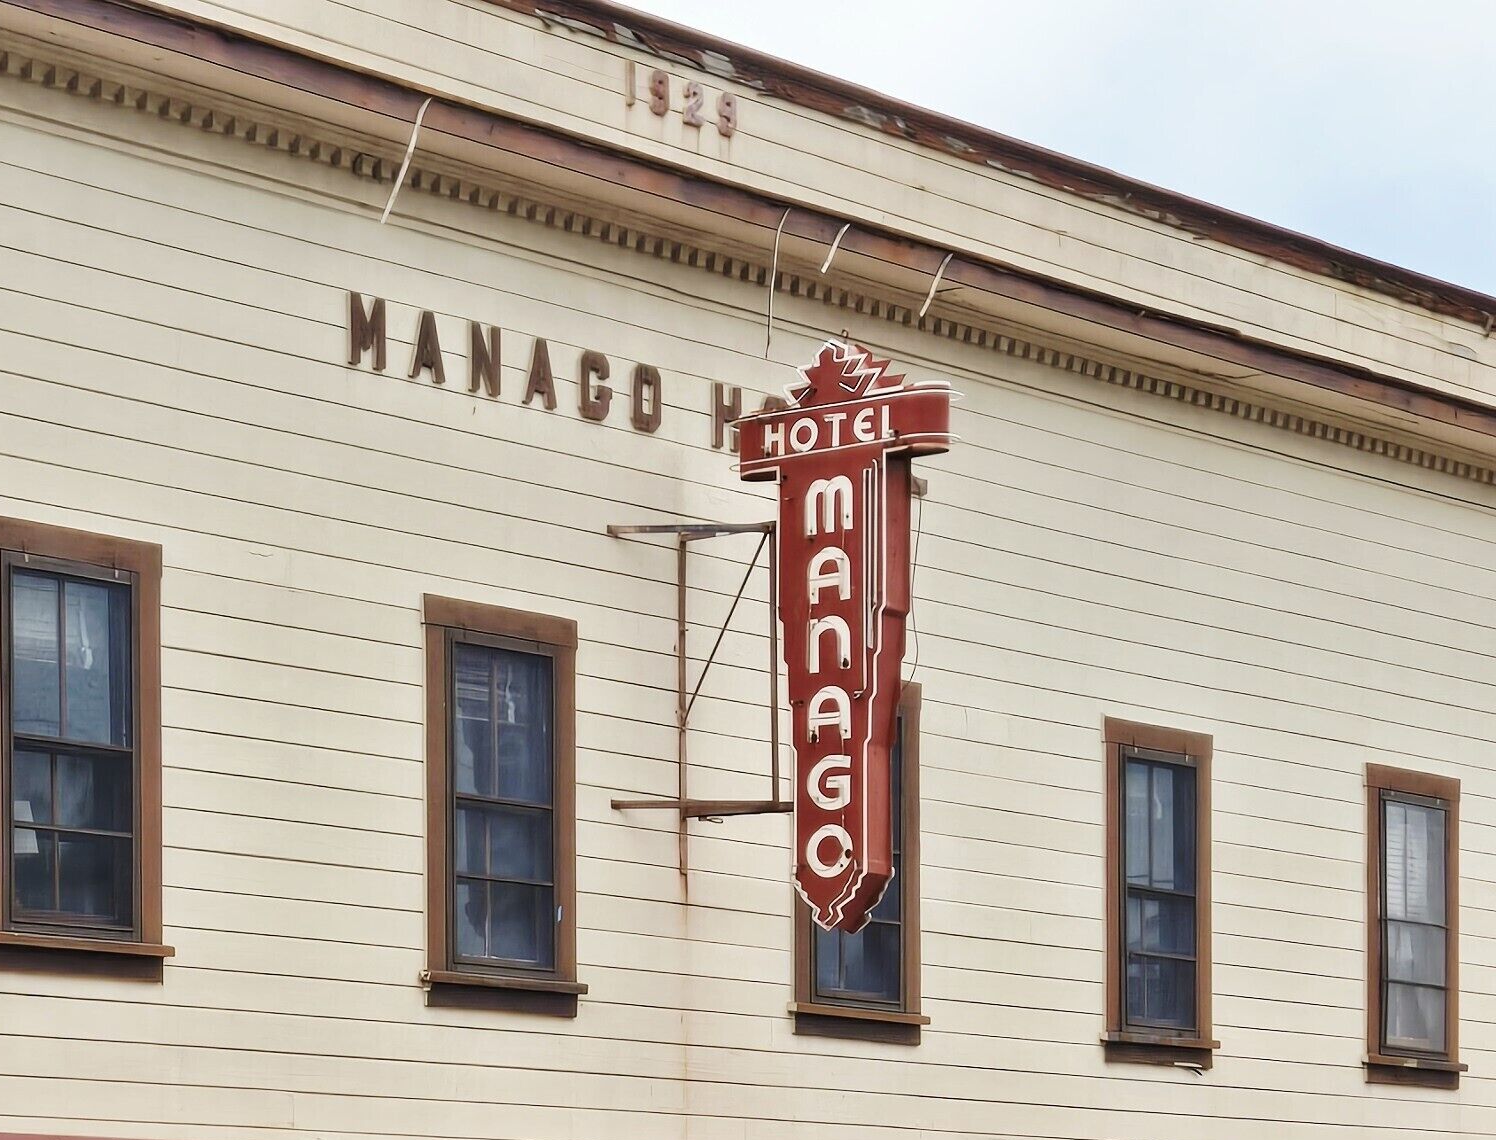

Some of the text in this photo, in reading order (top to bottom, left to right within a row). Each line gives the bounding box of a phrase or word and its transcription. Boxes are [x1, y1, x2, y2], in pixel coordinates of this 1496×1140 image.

[347, 290, 663, 433] MANAGO
[764, 404, 892, 457] HOTEL
[805, 474, 854, 879] MANAGO
